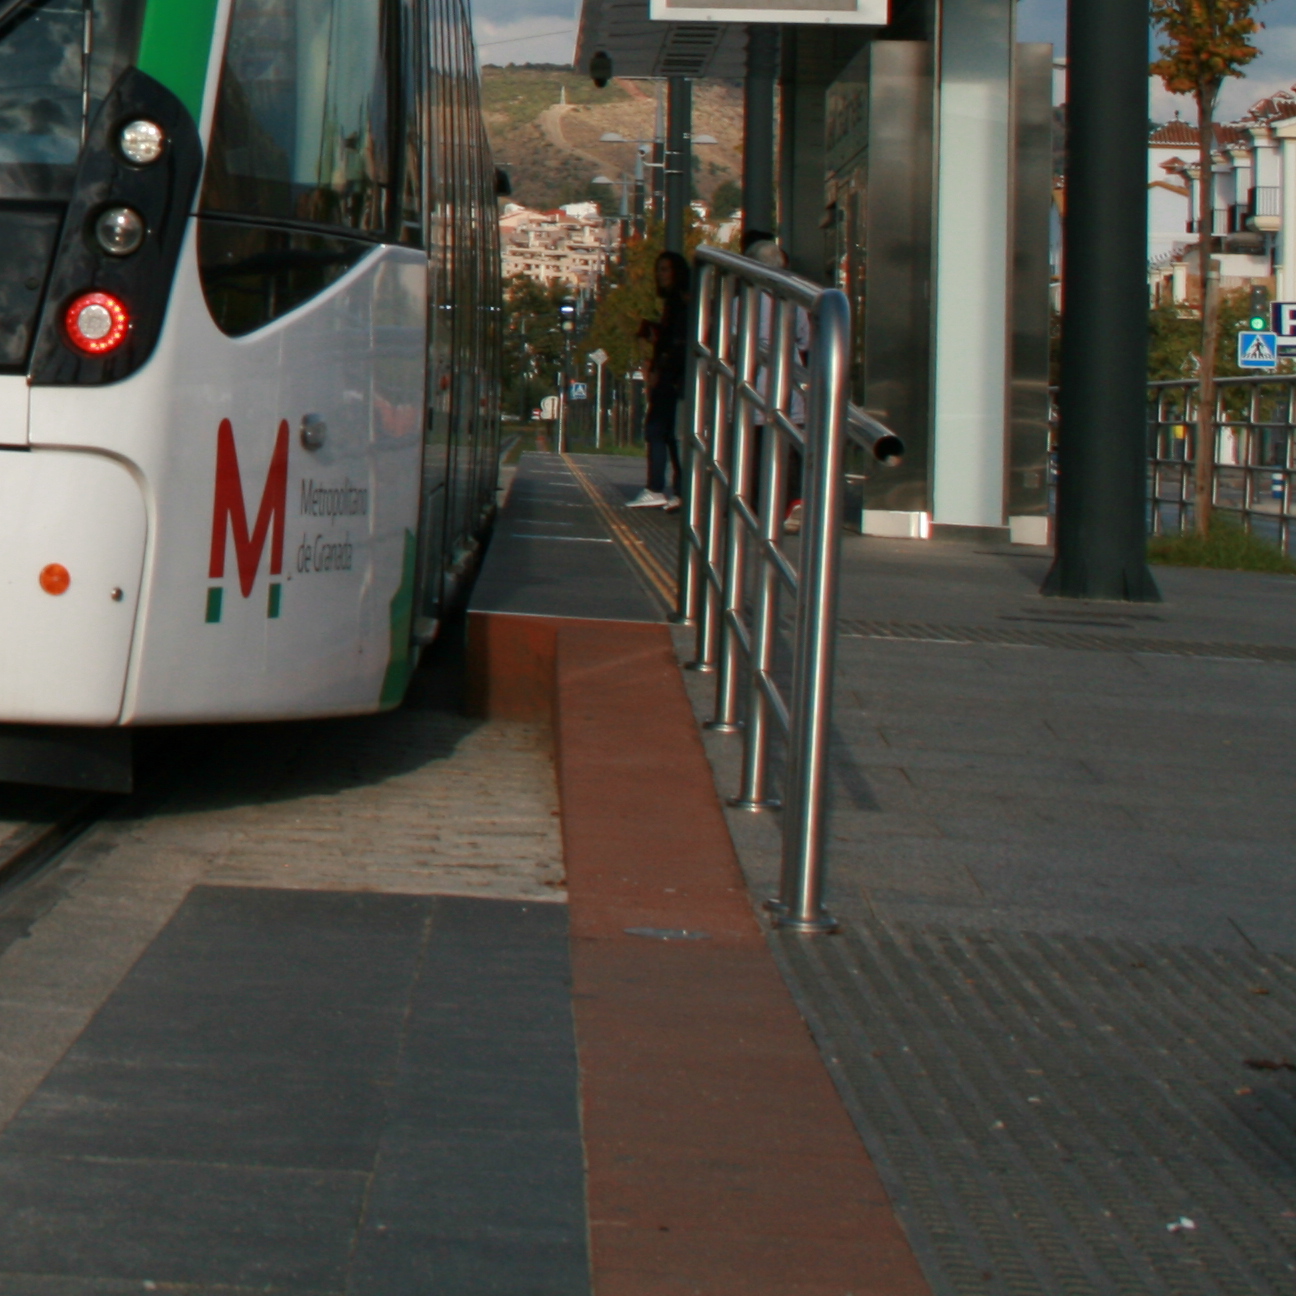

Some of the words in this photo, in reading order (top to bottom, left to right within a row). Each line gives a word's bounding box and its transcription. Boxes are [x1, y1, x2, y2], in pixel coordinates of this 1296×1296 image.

[205, 417, 289, 622] M
[300, 478, 368, 526] Metropolitano
[297, 532, 312, 574] de
[313, 532, 354, 573] Granada
